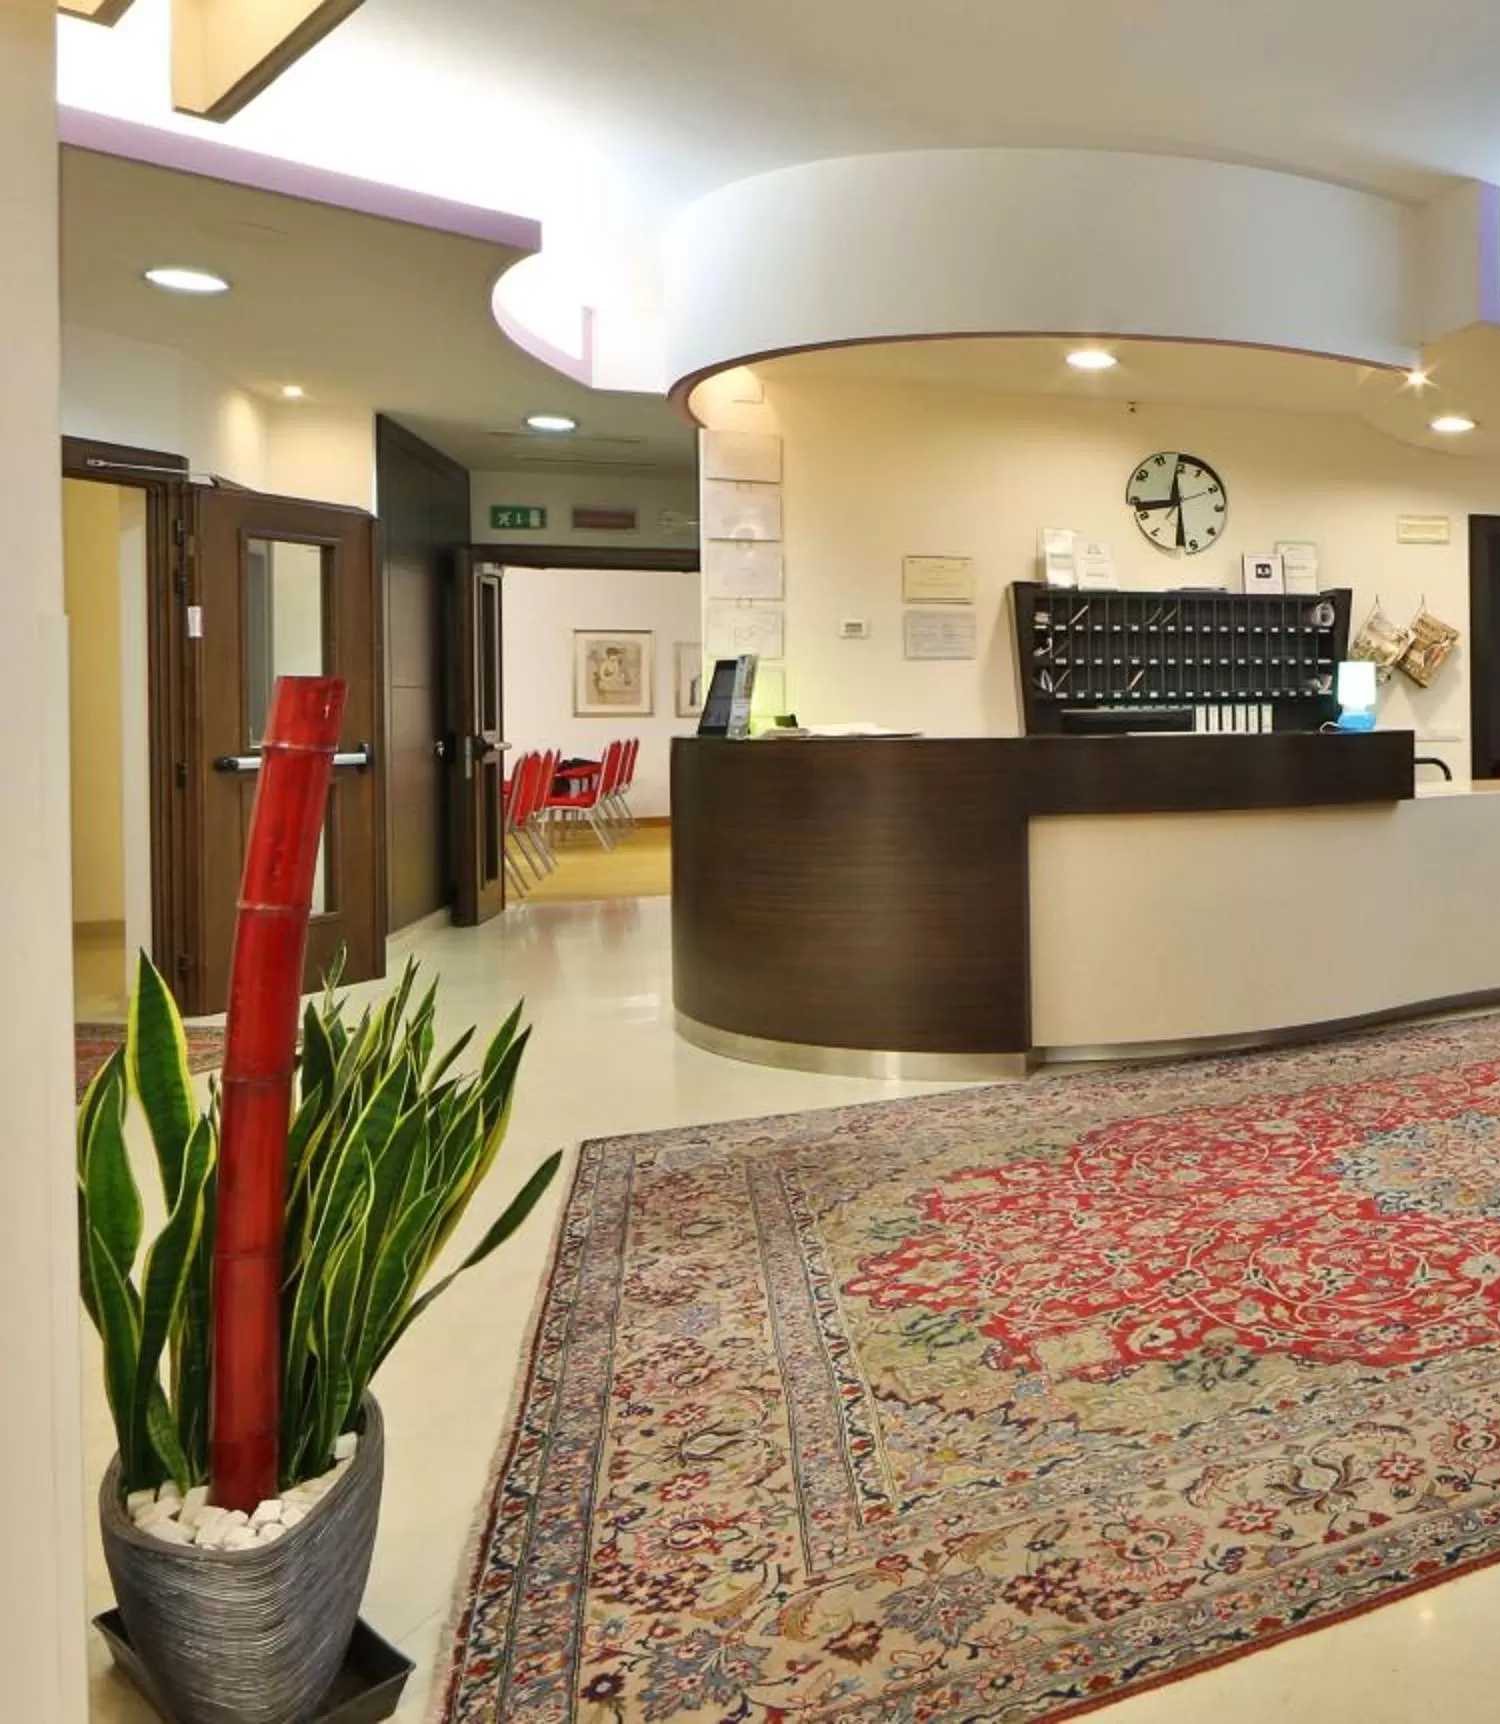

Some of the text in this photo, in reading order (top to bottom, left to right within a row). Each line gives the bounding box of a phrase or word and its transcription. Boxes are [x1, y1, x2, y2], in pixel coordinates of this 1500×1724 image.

[1135, 469, 1149, 481] 10
[1194, 469, 1202, 478] 1
[1207, 484, 1218, 494] 2
[1150, 527, 1160, 537] 7
[1189, 539, 1198, 550] 5
